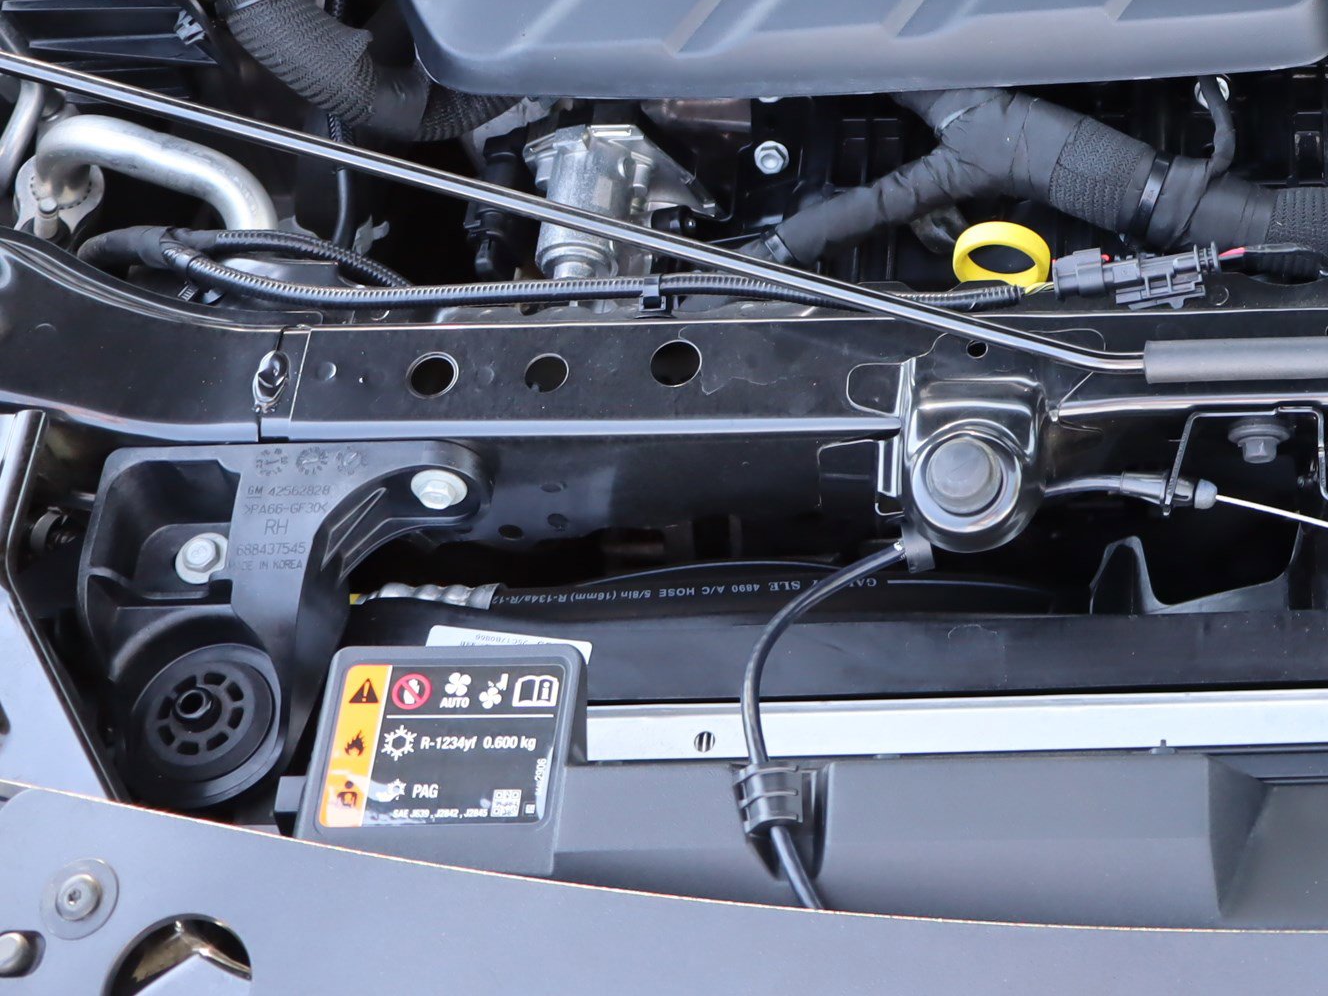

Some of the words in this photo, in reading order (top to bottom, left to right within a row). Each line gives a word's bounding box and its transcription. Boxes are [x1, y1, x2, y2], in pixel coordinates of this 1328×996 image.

[247, 485, 263, 498] GM
[264, 518, 289, 535] RH
[273, 560, 303, 570] KOREA
[658, 587, 696, 596] HOSE
[701, 586, 726, 596] A/C
[730, 584, 760, 594] 4890
[768, 580, 801, 592] SLE
[440, 696, 470, 709] AUTO
[420, 736, 477, 752] R-1234yf
[483, 736, 518, 749] 0.600
[520, 736, 536, 751] kg
[412, 784, 439, 798] PAG
[392, 808, 409, 818] SAE
